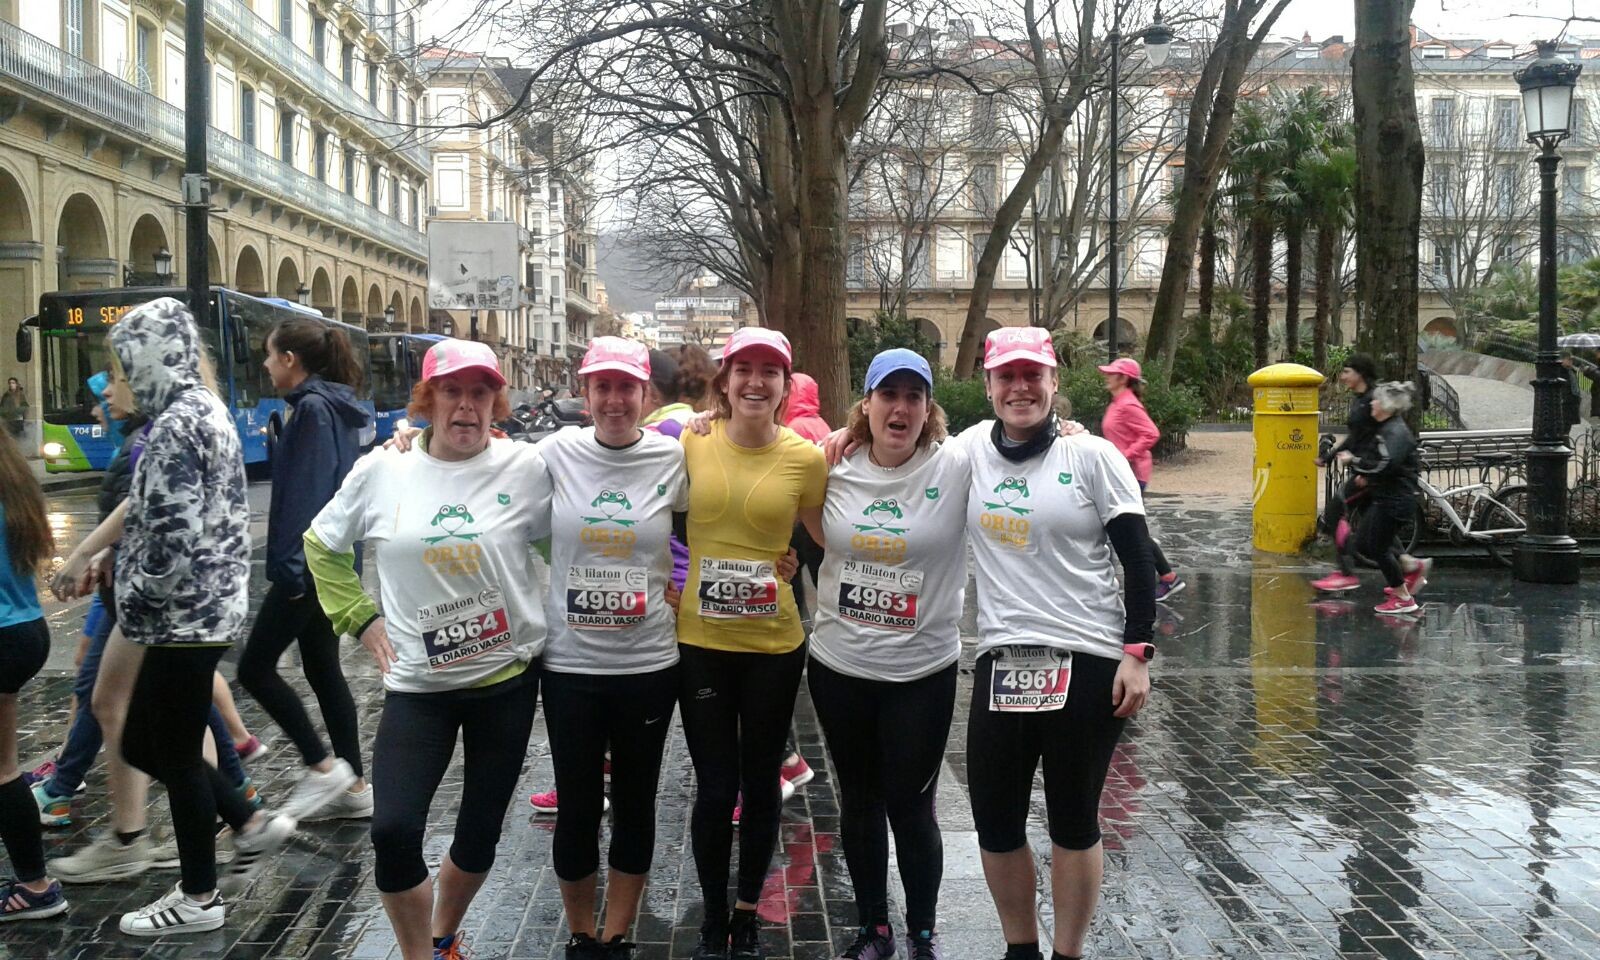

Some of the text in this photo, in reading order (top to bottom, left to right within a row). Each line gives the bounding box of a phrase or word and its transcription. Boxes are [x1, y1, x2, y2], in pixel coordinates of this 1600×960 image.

[68, 305, 133, 325] 18 SEM
[74, 427, 90, 435] 704
[980, 512, 1030, 535] ORIO
[580, 527, 638, 545] ORIO
[850, 534, 907, 553] ORIO
[423, 543, 482, 565] ORIO
[585, 568, 621, 579] lilaton
[702, 558, 715, 570] 29.
[717, 560, 753, 572] lilaton
[844, 561, 896, 580] 29. lilaton
[706, 581, 768, 600] 4962
[847, 586, 908, 612] 4963
[419, 608, 434, 620] 29.
[435, 596, 475, 616] lilaton
[574, 590, 637, 611] 4960
[702, 601, 711, 610] EL
[745, 604, 777, 613] VASCO
[568, 614, 646, 625] EL DIARIO VASCO
[839, 607, 916, 627] EL DIARIO VASCO
[433, 612, 499, 647] 4964
[429, 632, 511, 667] EL DIARIO VASCO
[1001, 669, 1058, 690] 4961
[992, 695, 1066, 705] EL DIARIO VASCO
